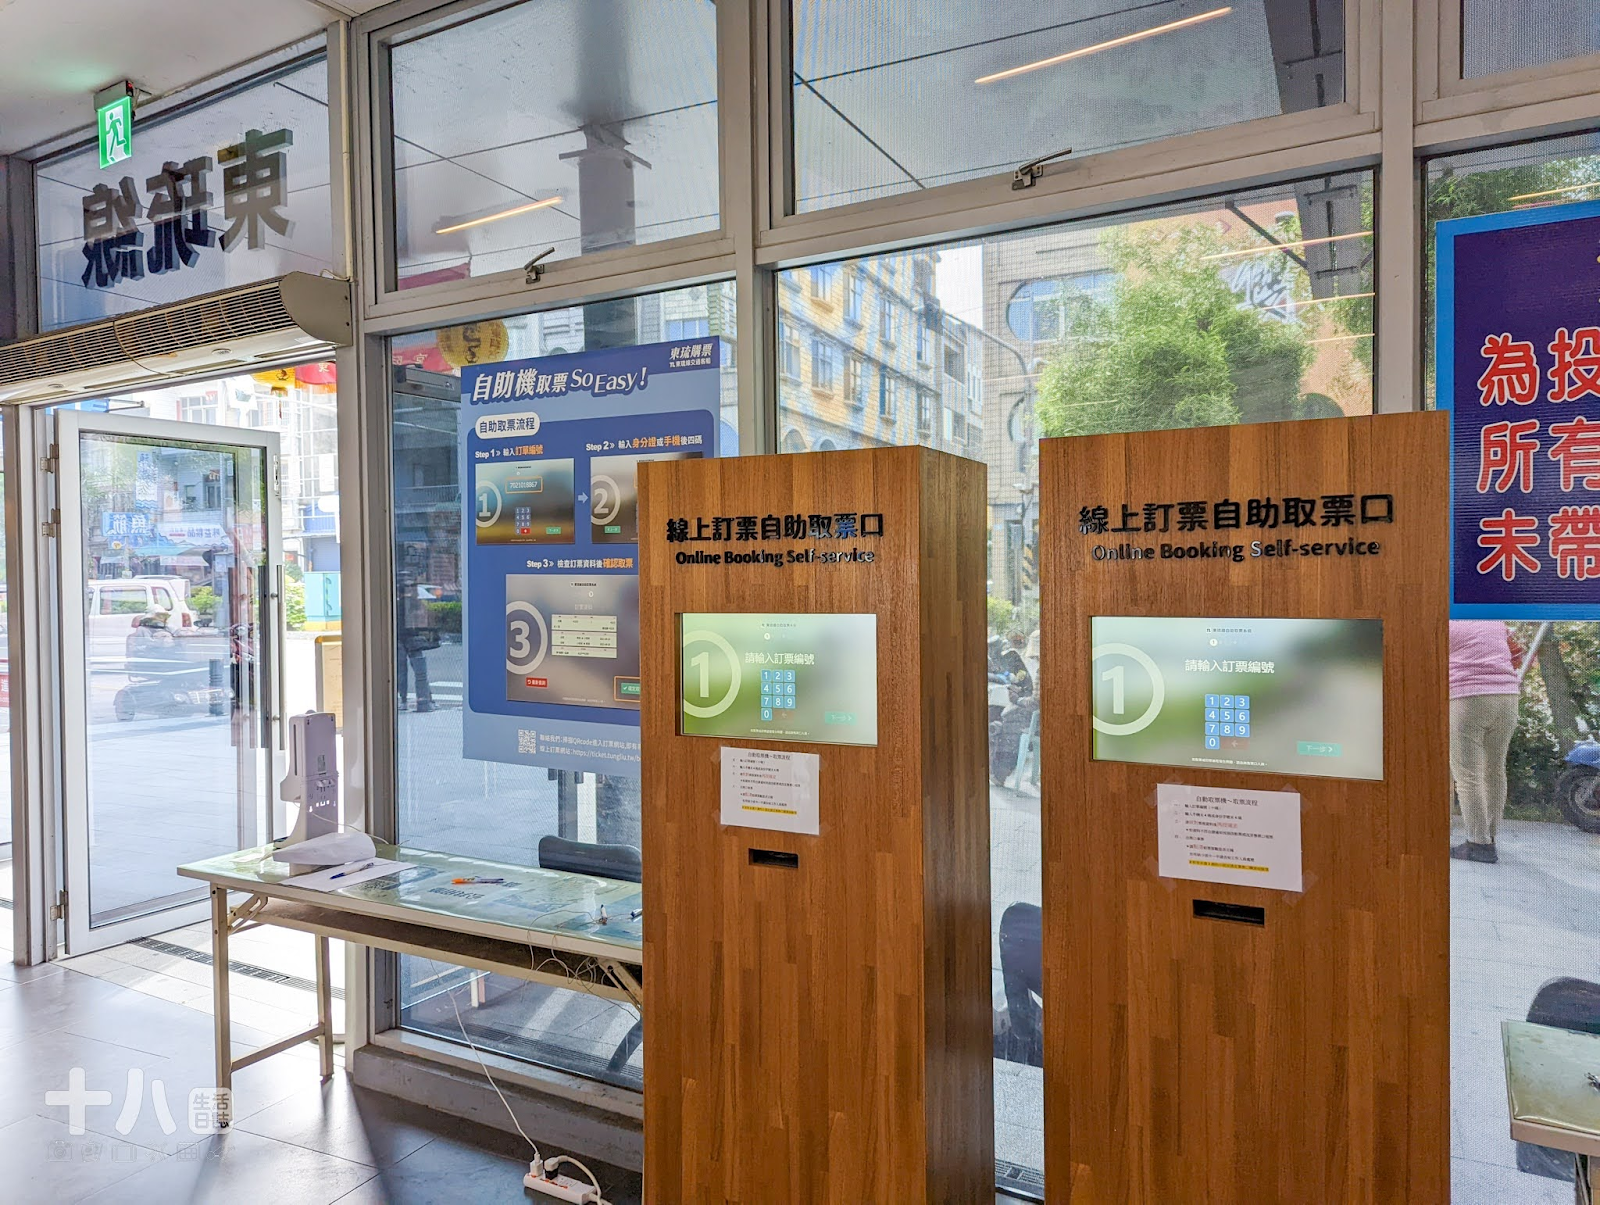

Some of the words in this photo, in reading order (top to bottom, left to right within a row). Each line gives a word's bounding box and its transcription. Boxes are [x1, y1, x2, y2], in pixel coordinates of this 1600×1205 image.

[1478, 327, 1600, 407] 為投
[472, 367, 569, 401] 自助機取票
[479, 417, 535, 434] 自助取票流程
[475, 450, 489, 459] Step
[586, 443, 602, 452] Step
[1477, 416, 1600, 494] 所有
[478, 493, 491, 517] 1
[594, 488, 609, 514] 2
[1078, 493, 1394, 536] 線上訂票自助取票口
[666, 513, 884, 543] 線上訂票自助取票口
[1092, 543, 1155, 561] Online
[1160, 540, 1244, 563] Booking
[1250, 537, 1380, 558] Self-service
[1477, 505, 1600, 582] 未帶
[526, 560, 542, 569] Step
[675, 551, 721, 565] Online
[724, 549, 784, 567] Booking
[786, 547, 875, 564] Self-service
[509, 620, 531, 658] 3
[745, 652, 815, 665] 請輸入訂票編號
[1185, 659, 1275, 674] 請輸入訂票編號
[690, 651, 709, 698] 1
[1101, 665, 1125, 715] 1
